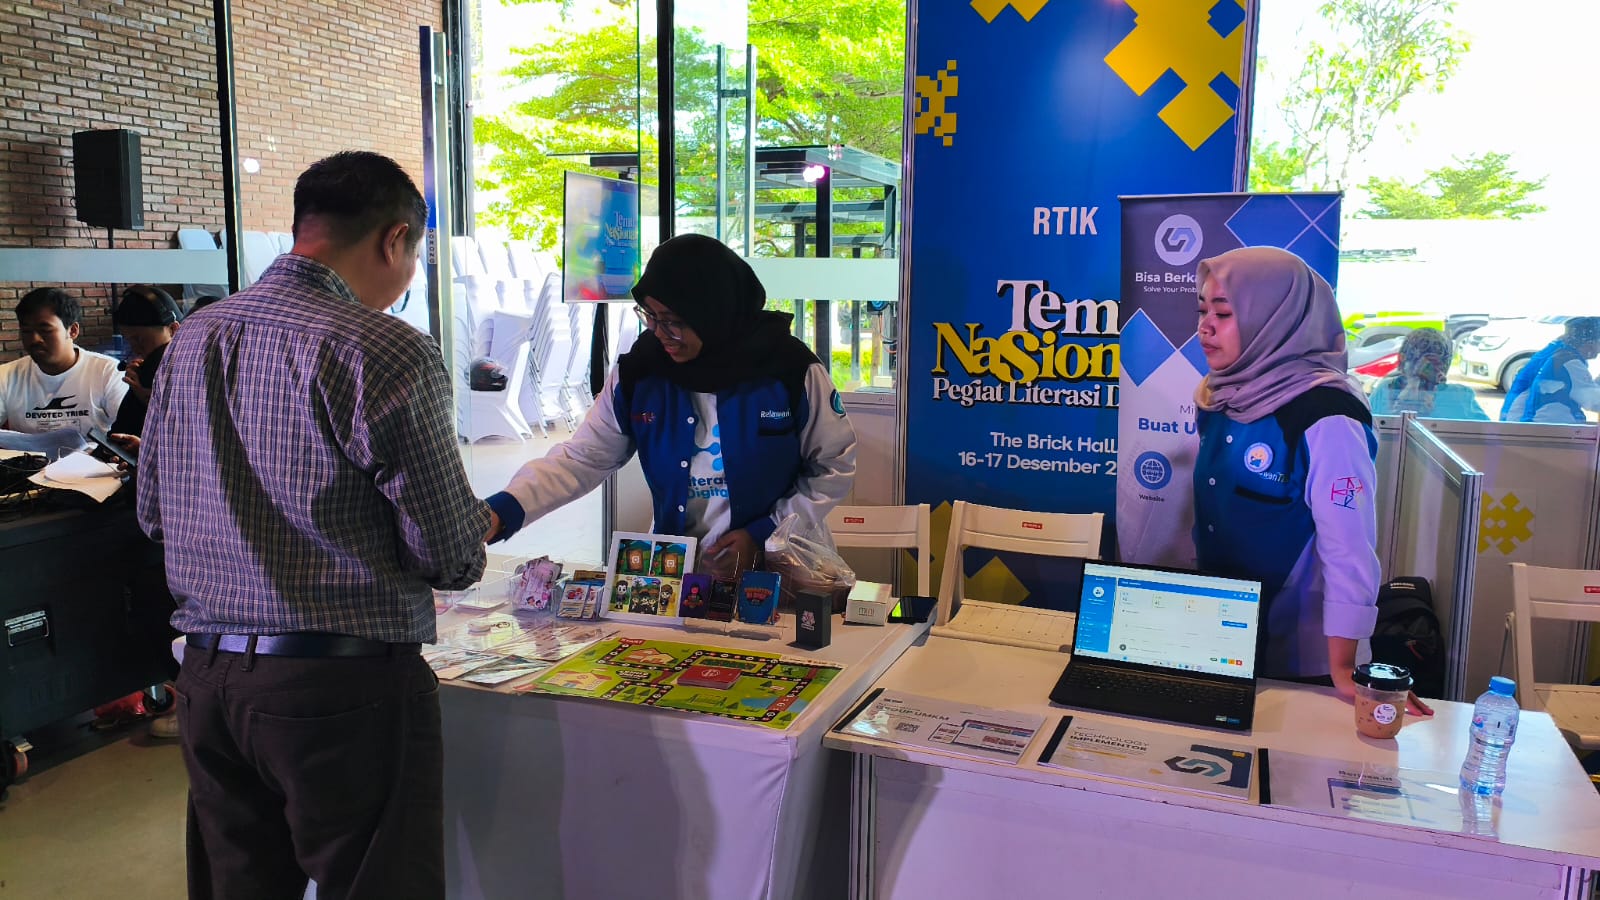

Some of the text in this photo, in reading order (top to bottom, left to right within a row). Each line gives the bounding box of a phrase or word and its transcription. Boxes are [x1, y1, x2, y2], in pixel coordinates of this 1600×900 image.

[1033, 206, 1099, 236] RTIK
[1135, 271, 1160, 283] Bisa
[1143, 285, 1161, 294] Solve
[1162, 286, 1179, 294] Your
[932, 377, 1003, 408] Pegiat
[1007, 381, 1101, 407] Literasi
[65, 409, 90, 417] TRIBE
[1138, 417, 1179, 434] Buat
[990, 431, 1118, 454] The Brick Hall
[958, 451, 1003, 468] 16-17
[1007, 454, 1101, 475] Desember
[1138, 493, 1165, 503] Website
[1069, 735, 1148, 751] IMPLEMENTOR
[1073, 731, 1150, 746] TECHNOLOGY
